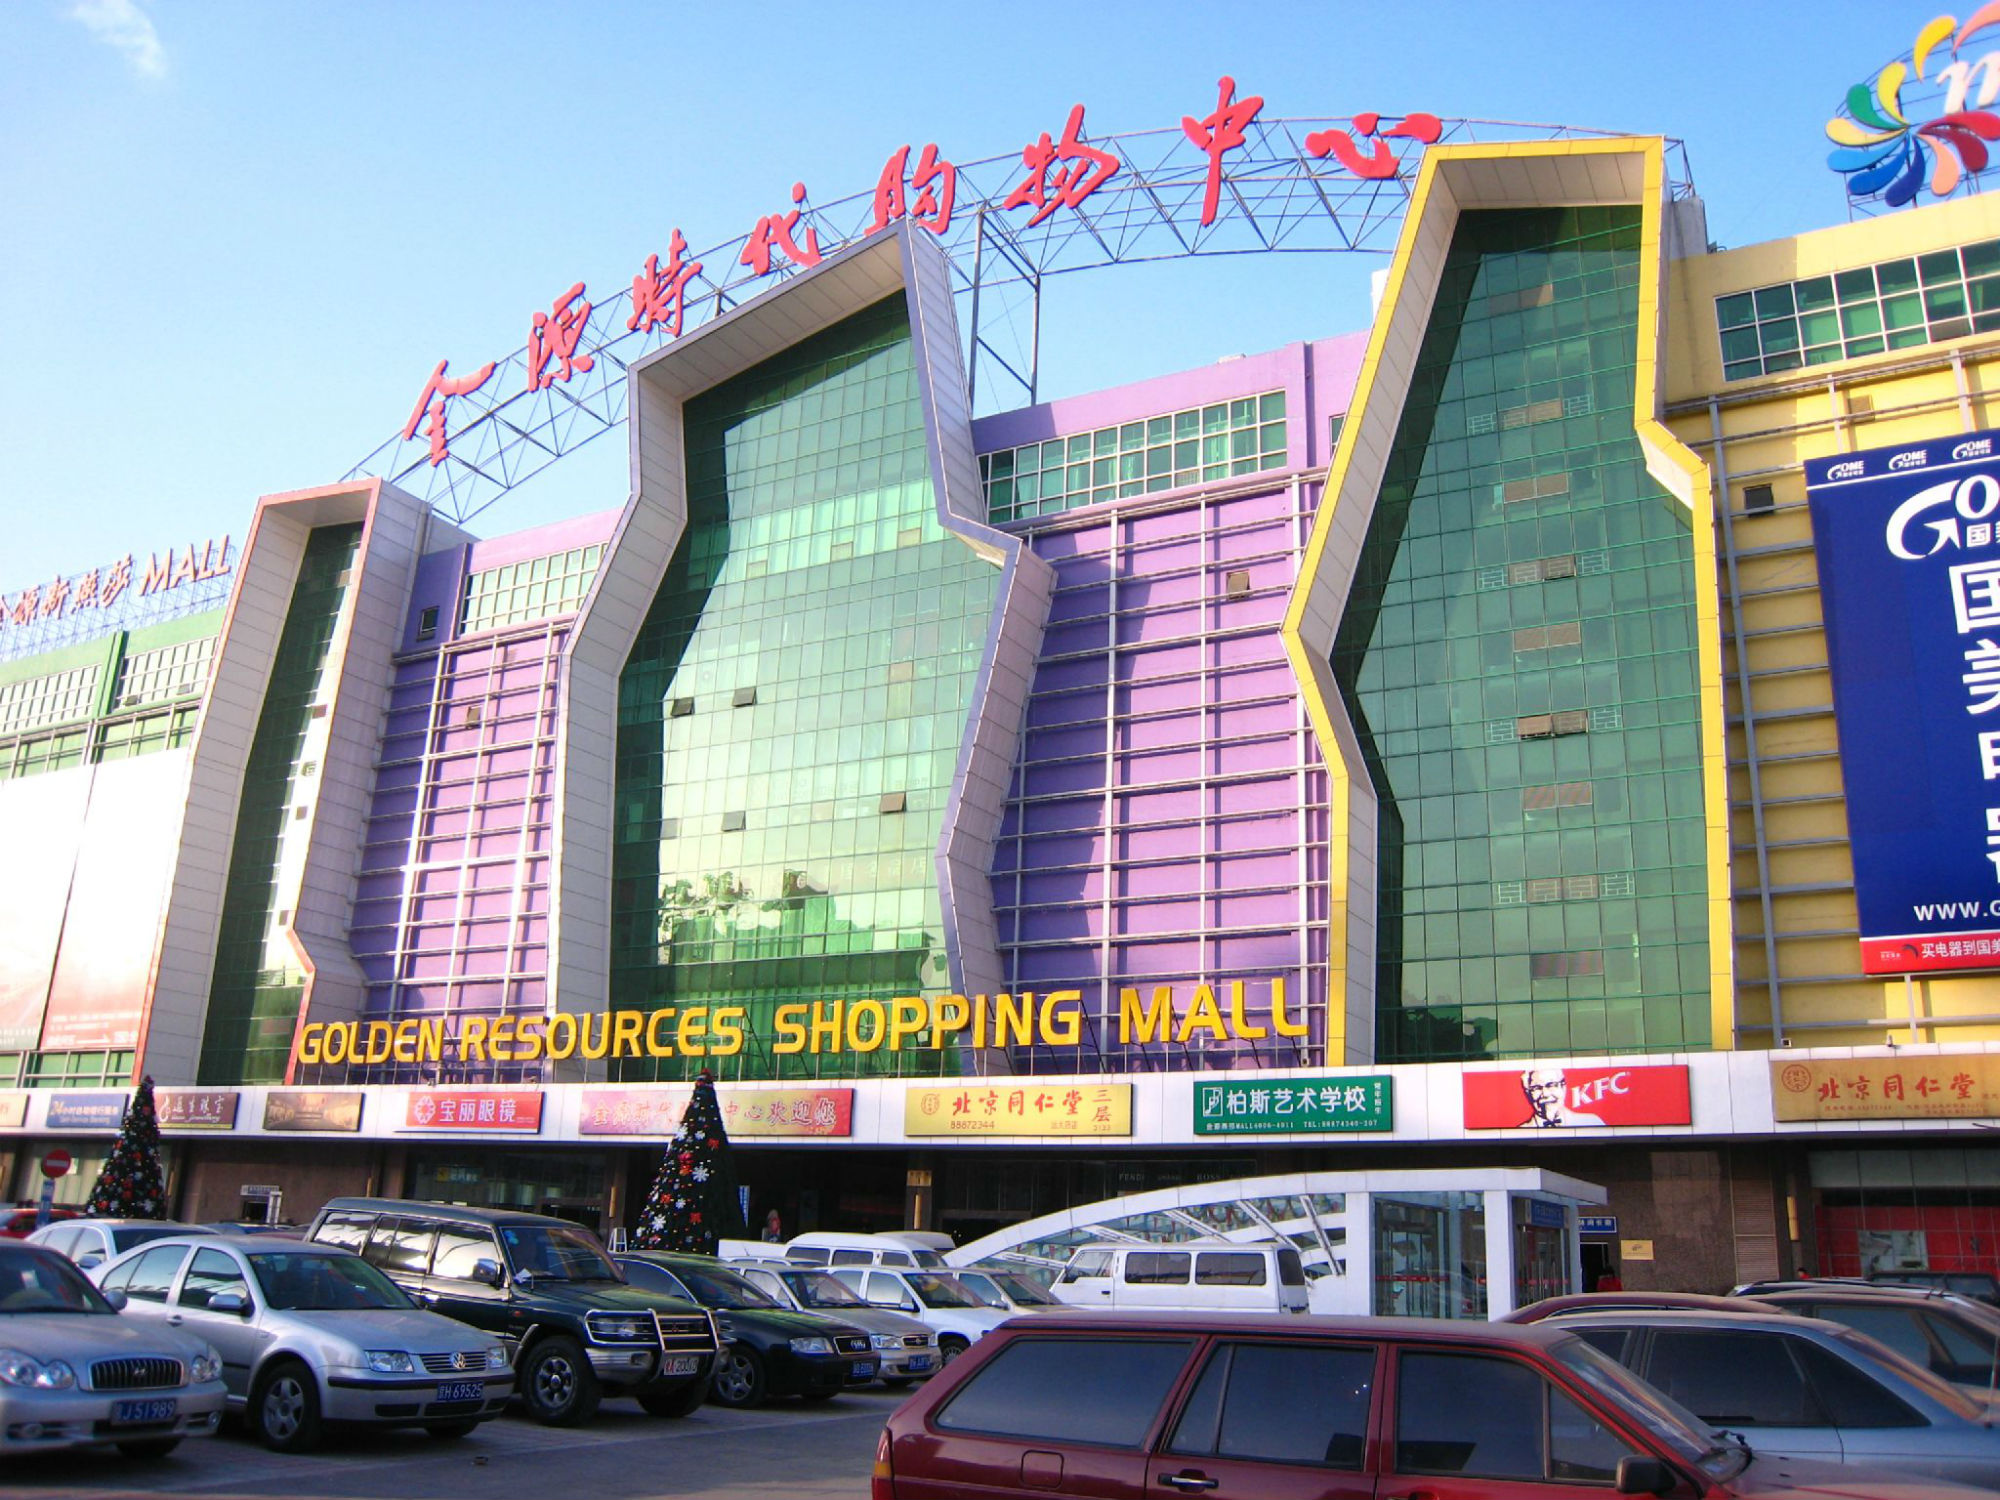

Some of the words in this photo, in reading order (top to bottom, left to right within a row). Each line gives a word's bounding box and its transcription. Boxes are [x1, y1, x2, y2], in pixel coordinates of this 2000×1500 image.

[138, 534, 231, 597] MALL
[298, 1019, 446, 1065] GOLDEN
[460, 1007, 746, 1062] RESOURCES
[773, 990, 1082, 1055] SHOPPING
[1120, 977, 1309, 1044] MALL
[1226, 1086, 1367, 1115] 柏斯艺术学校
[1571, 1071, 1629, 1108] KFC
[1817, 1073, 1974, 1102] 北京同仁堂
[438, 1098, 516, 1123] 宝丽眼镜
[592, 1098, 837, 1127] 金源时代中心欢迎您
[952, 1089, 1083, 1116] 北京同仁堂
[950, 1120, 995, 1130] 88872344
